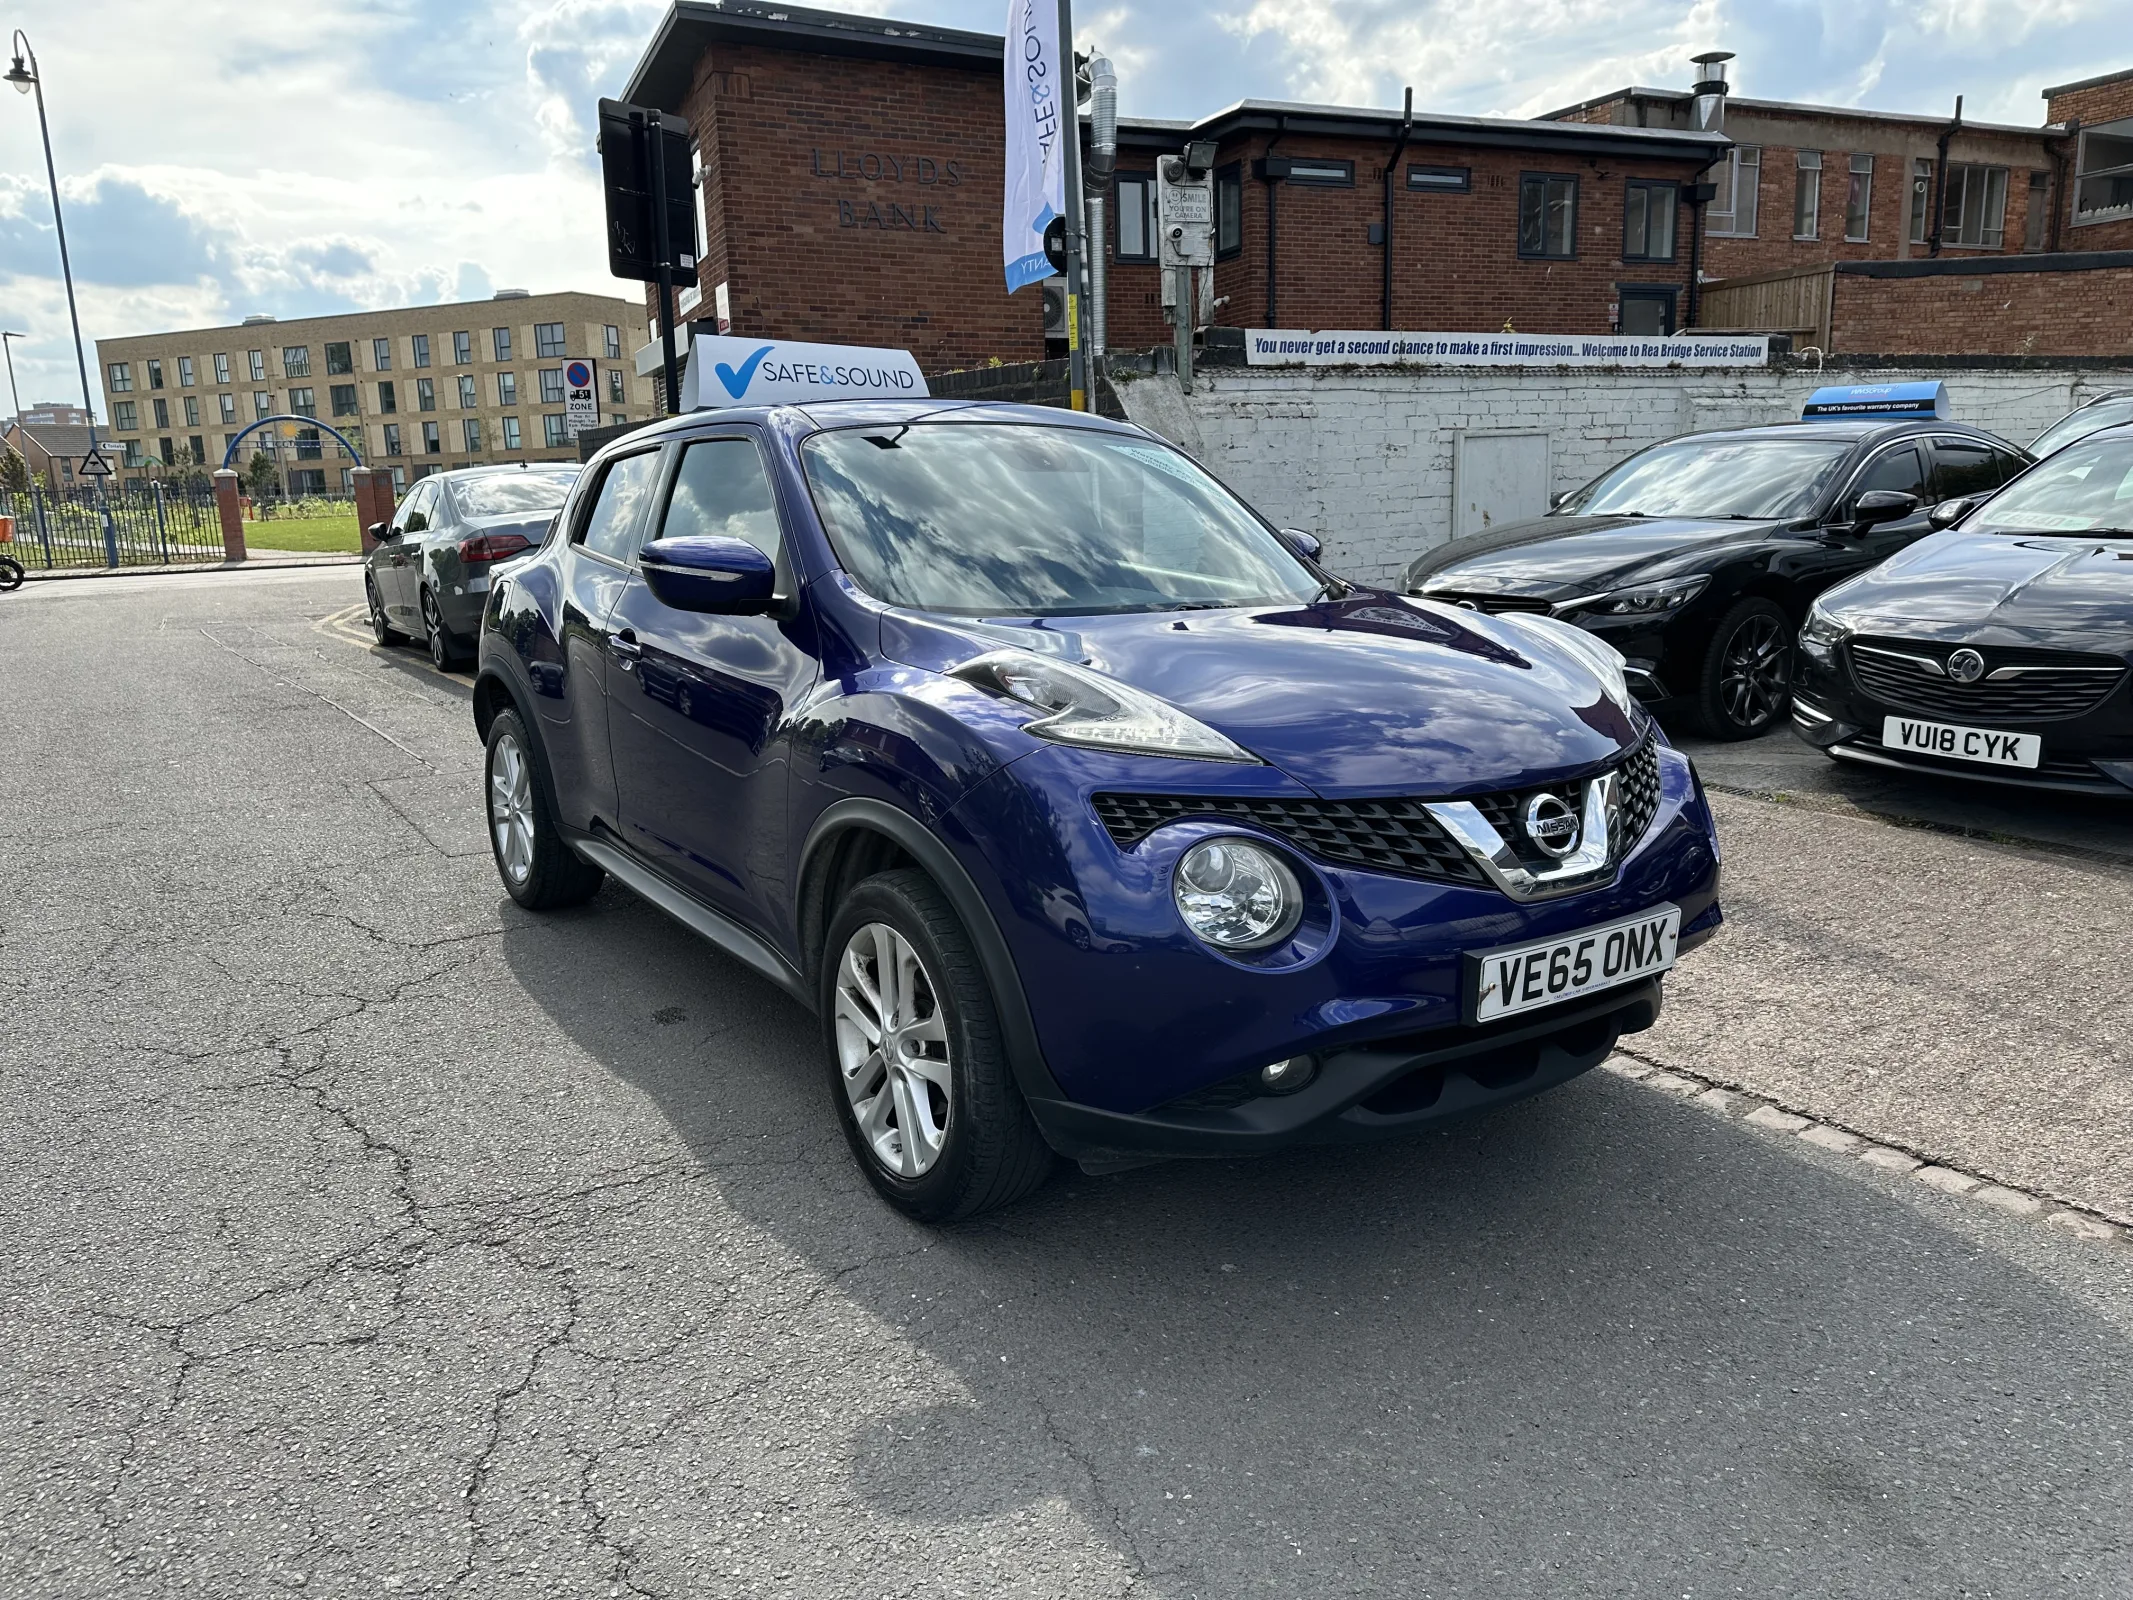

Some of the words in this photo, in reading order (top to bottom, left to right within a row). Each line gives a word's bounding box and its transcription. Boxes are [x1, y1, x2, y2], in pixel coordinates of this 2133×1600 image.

[813, 147, 961, 186] LLOYDS
[1182, 193, 1206, 203] SMILE
[838, 200, 947, 234] BANK
[1256, 338, 1277, 354] You
[1280, 340, 1314, 354] never
[1315, 340, 1336, 355] get
[1338, 342, 1345, 354] a
[1347, 340, 1390, 355] second
[1392, 340, 1433, 355] chance
[1436, 341, 1448, 355] to
[1449, 341, 1480, 355] make
[1482, 343, 1488, 355] a
[1490, 341, 1513, 356] first
[1582, 343, 1628, 357] Welcome
[1630, 344, 1640, 357] to
[1641, 344, 1659, 357] Rea
[1660, 344, 1692, 358] Bridge
[1694, 344, 1728, 357] Service
[1729, 344, 1762, 357] Station
[762, 362, 914, 389] SAFE&SOUND
[569, 403, 593, 411] ZONE
[1867, 403, 1892, 411] warranty
[1892, 402, 1920, 410] company
[1901, 722, 1956, 752] VU18
[1963, 732, 2021, 761] CYK
[1536, 818, 1578, 834] NISSAN
[1500, 938, 1596, 1007] VE65
[1603, 918, 1668, 978] ONX
